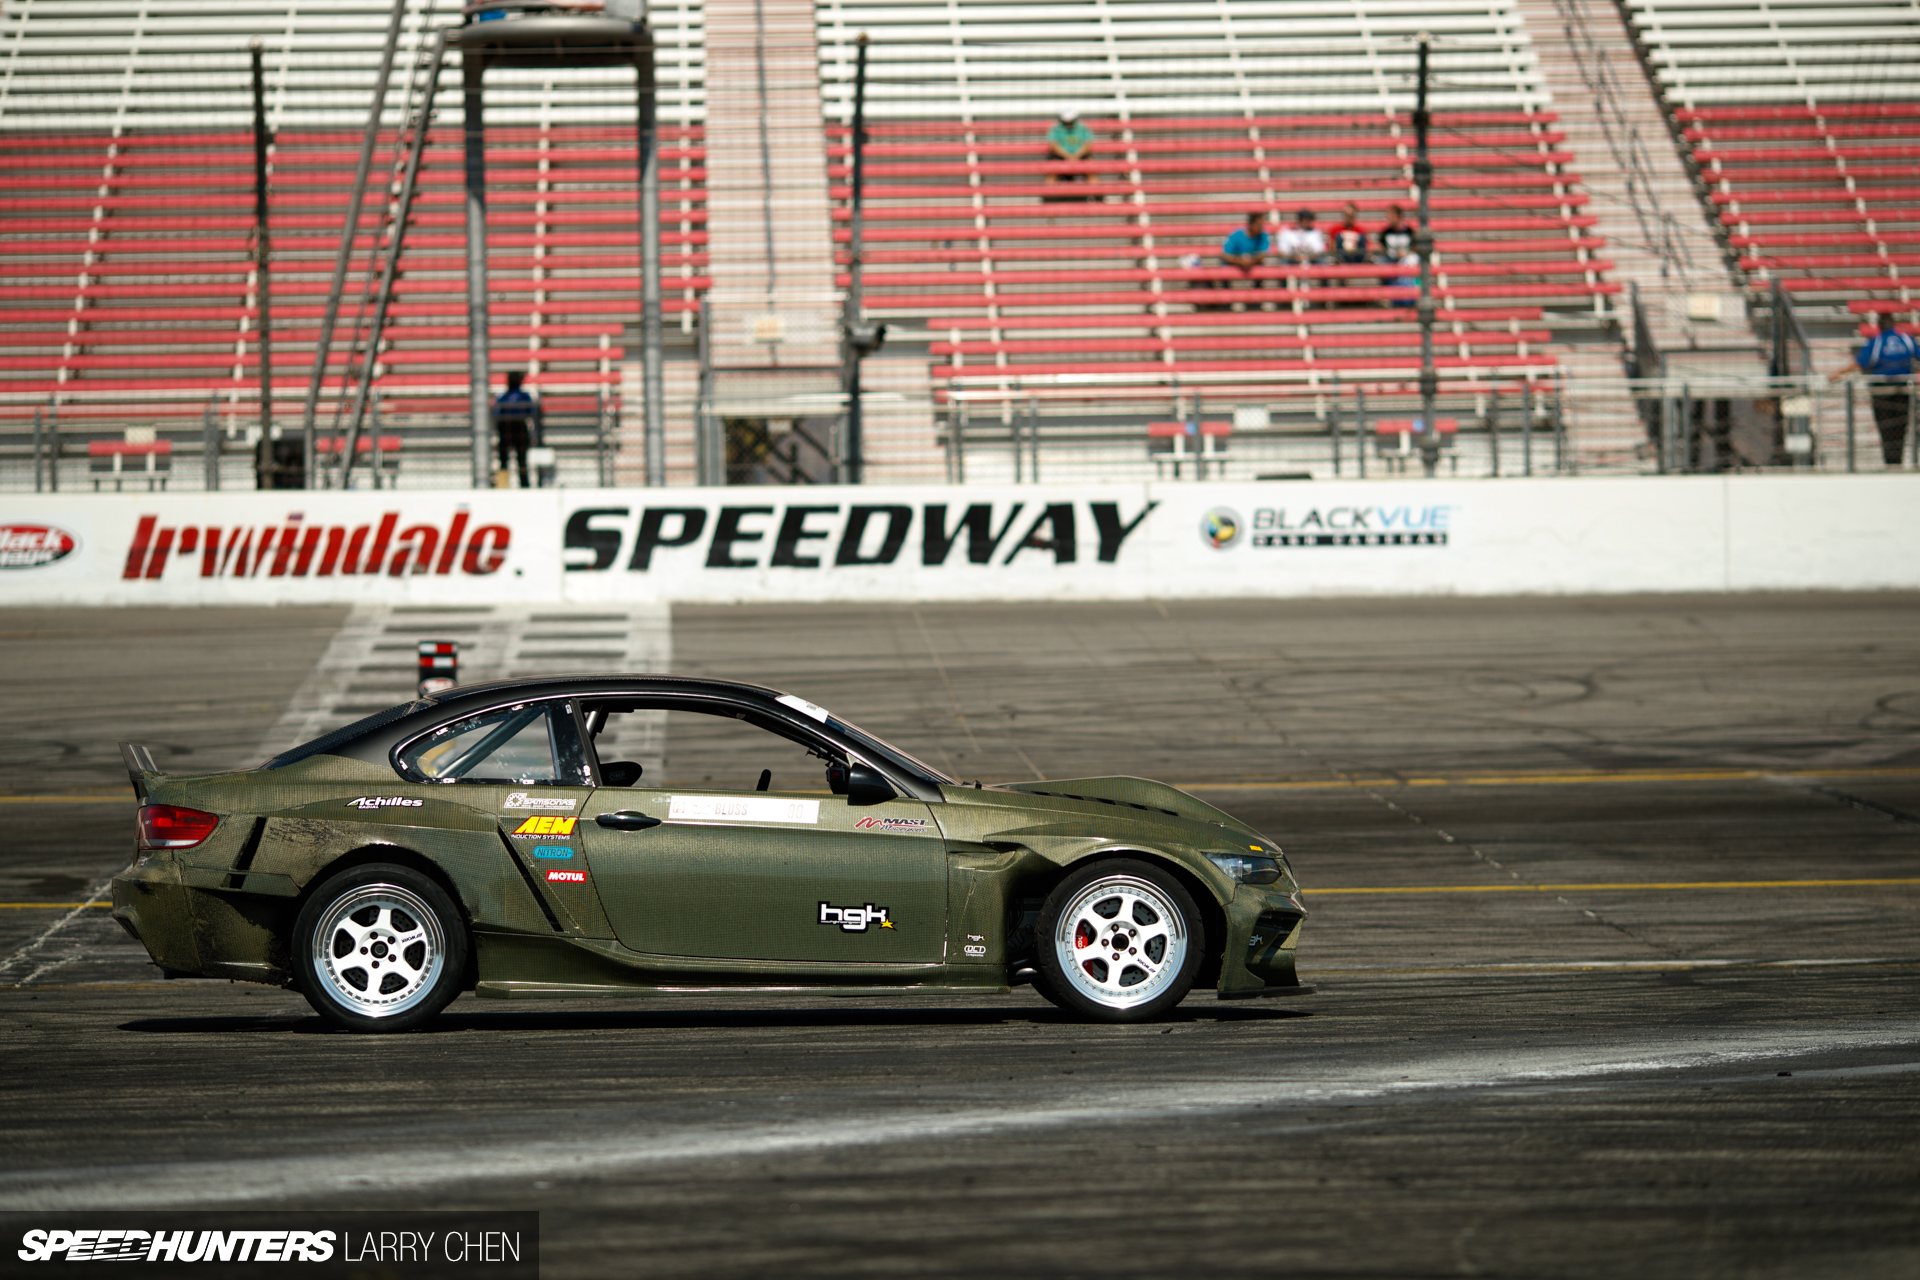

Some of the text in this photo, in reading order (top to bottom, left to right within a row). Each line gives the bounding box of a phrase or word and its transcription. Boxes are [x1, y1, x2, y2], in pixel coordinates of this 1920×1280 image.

[1253, 506, 1451, 529] BLACKVUE
[0, 528, 61, 549] lack
[563, 502, 1163, 572] SPEEDWAY
[346, 796, 424, 807] Achilles
[715, 803, 749, 816] BLUSS
[512, 815, 579, 835] AEM
[883, 818, 926, 826] MAST
[537, 848, 569, 857] NITRON
[548, 871, 585, 882] MOTUL
[820, 903, 887, 931] hgk
[1249, 933, 1263, 946] gk
